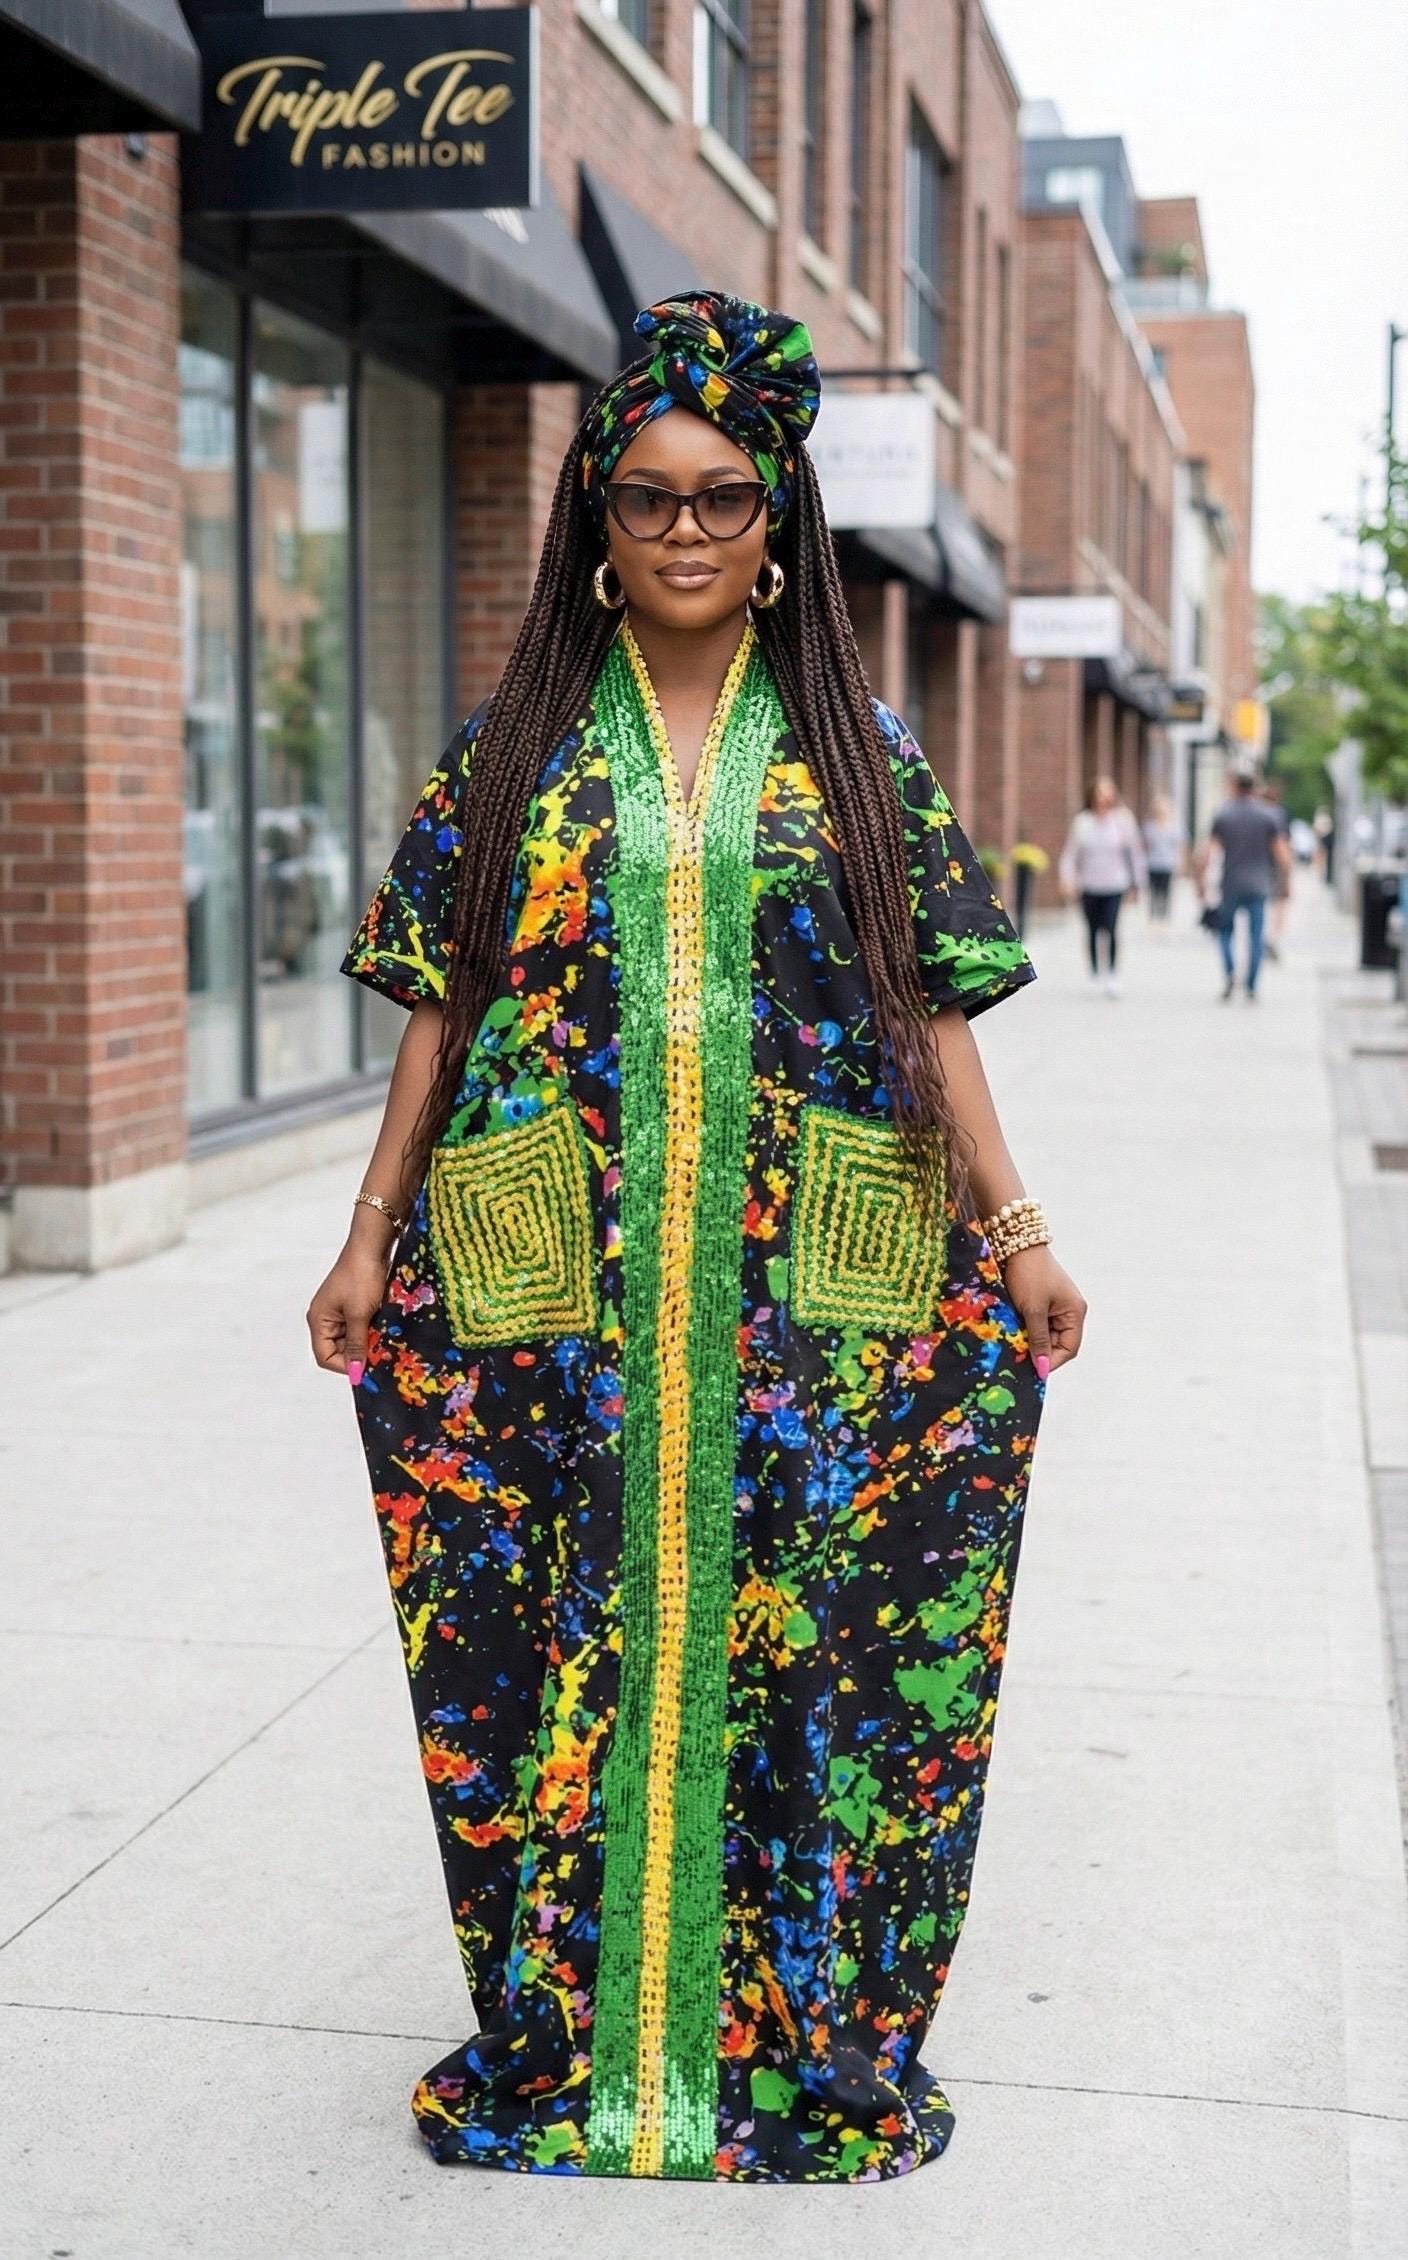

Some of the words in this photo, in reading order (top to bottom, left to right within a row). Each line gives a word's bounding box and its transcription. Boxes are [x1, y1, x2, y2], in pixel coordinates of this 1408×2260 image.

[216, 56, 399, 168] Triple
[404, 50, 515, 140] Tee
[322, 141, 485, 169] FASHION
